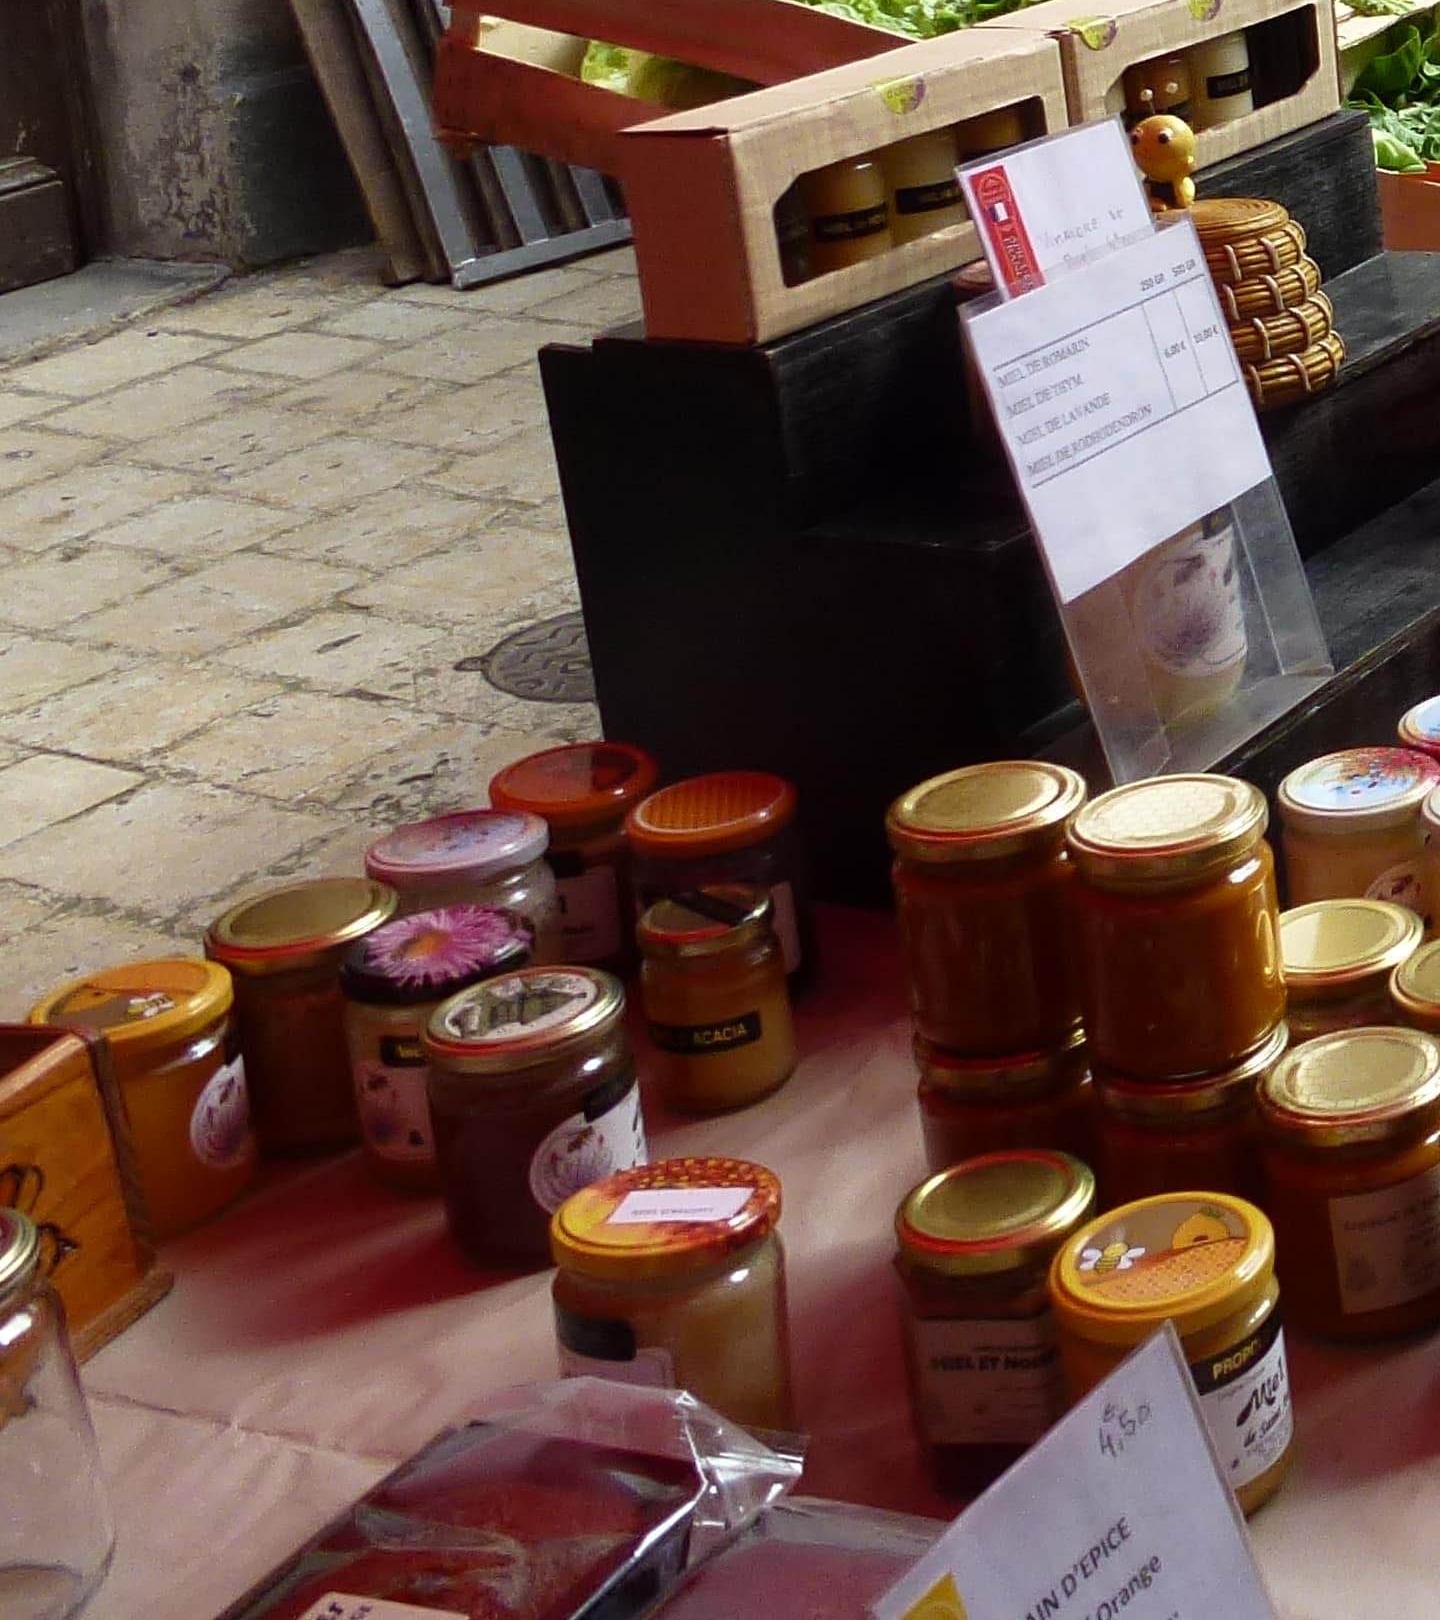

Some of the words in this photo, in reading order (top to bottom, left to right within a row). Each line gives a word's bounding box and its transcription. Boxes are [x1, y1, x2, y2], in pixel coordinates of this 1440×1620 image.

[998, 362, 1026, 388] MIEL
[1025, 357, 1042, 376] DE
[1042, 337, 1091, 370] ROMARIN
[1006, 395, 1035, 419] MIEL
[1035, 388, 1052, 408] DE
[1018, 422, 1046, 446] MIEL
[1046, 413, 1063, 434] DE
[1062, 392, 1113, 425] LAVANDE
[1027, 453, 1055, 477] MIEL
[1055, 445, 1072, 467] DE
[692, 1022, 747, 1045] ACACIA
[1236, 1355, 1284, 1428] Miel
[1060, 1516, 1132, 1599] D'EPICE
